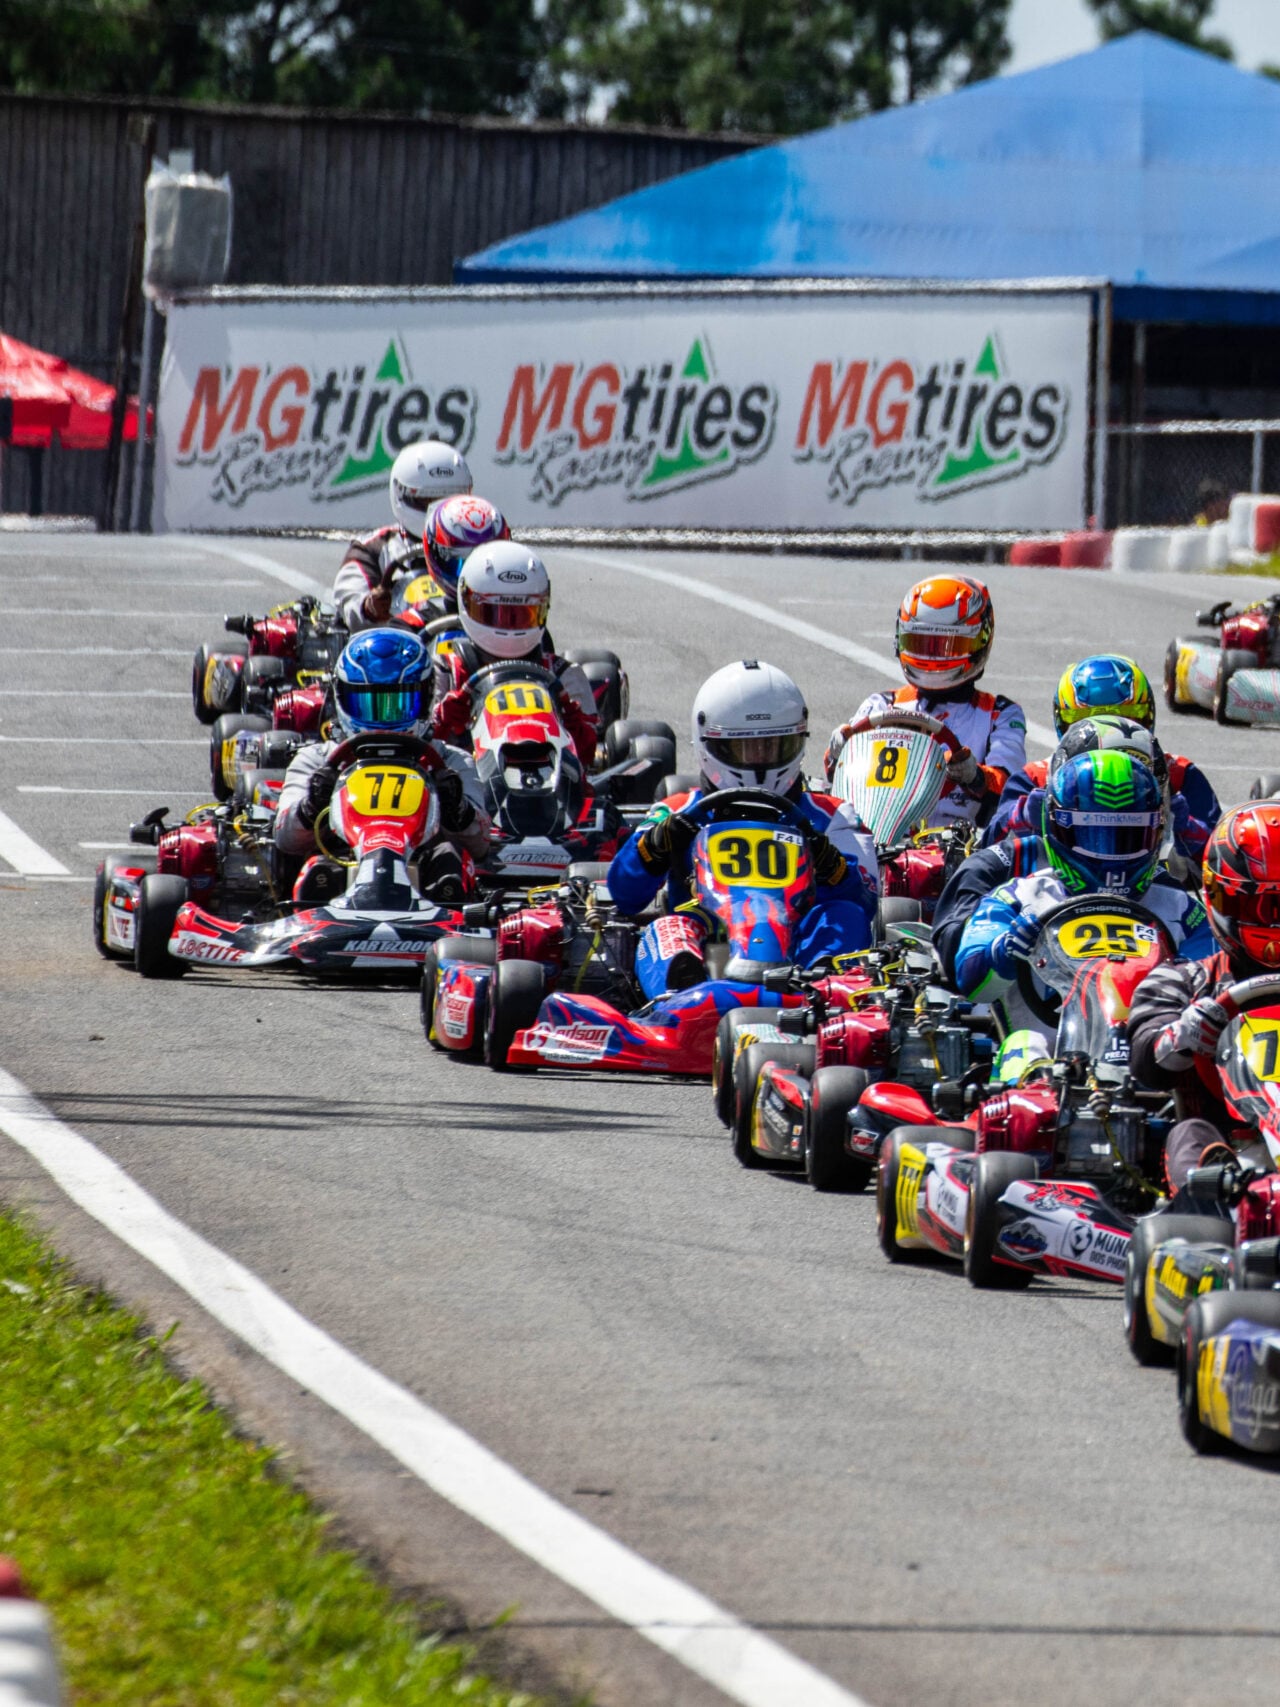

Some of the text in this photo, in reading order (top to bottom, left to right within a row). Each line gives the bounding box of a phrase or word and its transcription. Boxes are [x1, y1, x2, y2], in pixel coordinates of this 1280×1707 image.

[178, 365, 469, 453] MGtires
[496, 362, 770, 452] MGtires
[795, 359, 1061, 450] MGtires
[212, 432, 347, 500] Racing
[530, 432, 656, 500] Racing
[827, 430, 948, 500] Racing
[490, 687, 545, 711] 111
[889, 740, 904, 748] F4
[874, 748, 899, 783] 8
[365, 772, 407, 810] 77
[1093, 813, 1143, 824] ThinkMed
[776, 833, 794, 844] F4
[718, 837, 788, 881] 30
[1074, 922, 1138, 953] 25
[1136, 925, 1154, 936] F4
[177, 938, 247, 962] LOCTITE
